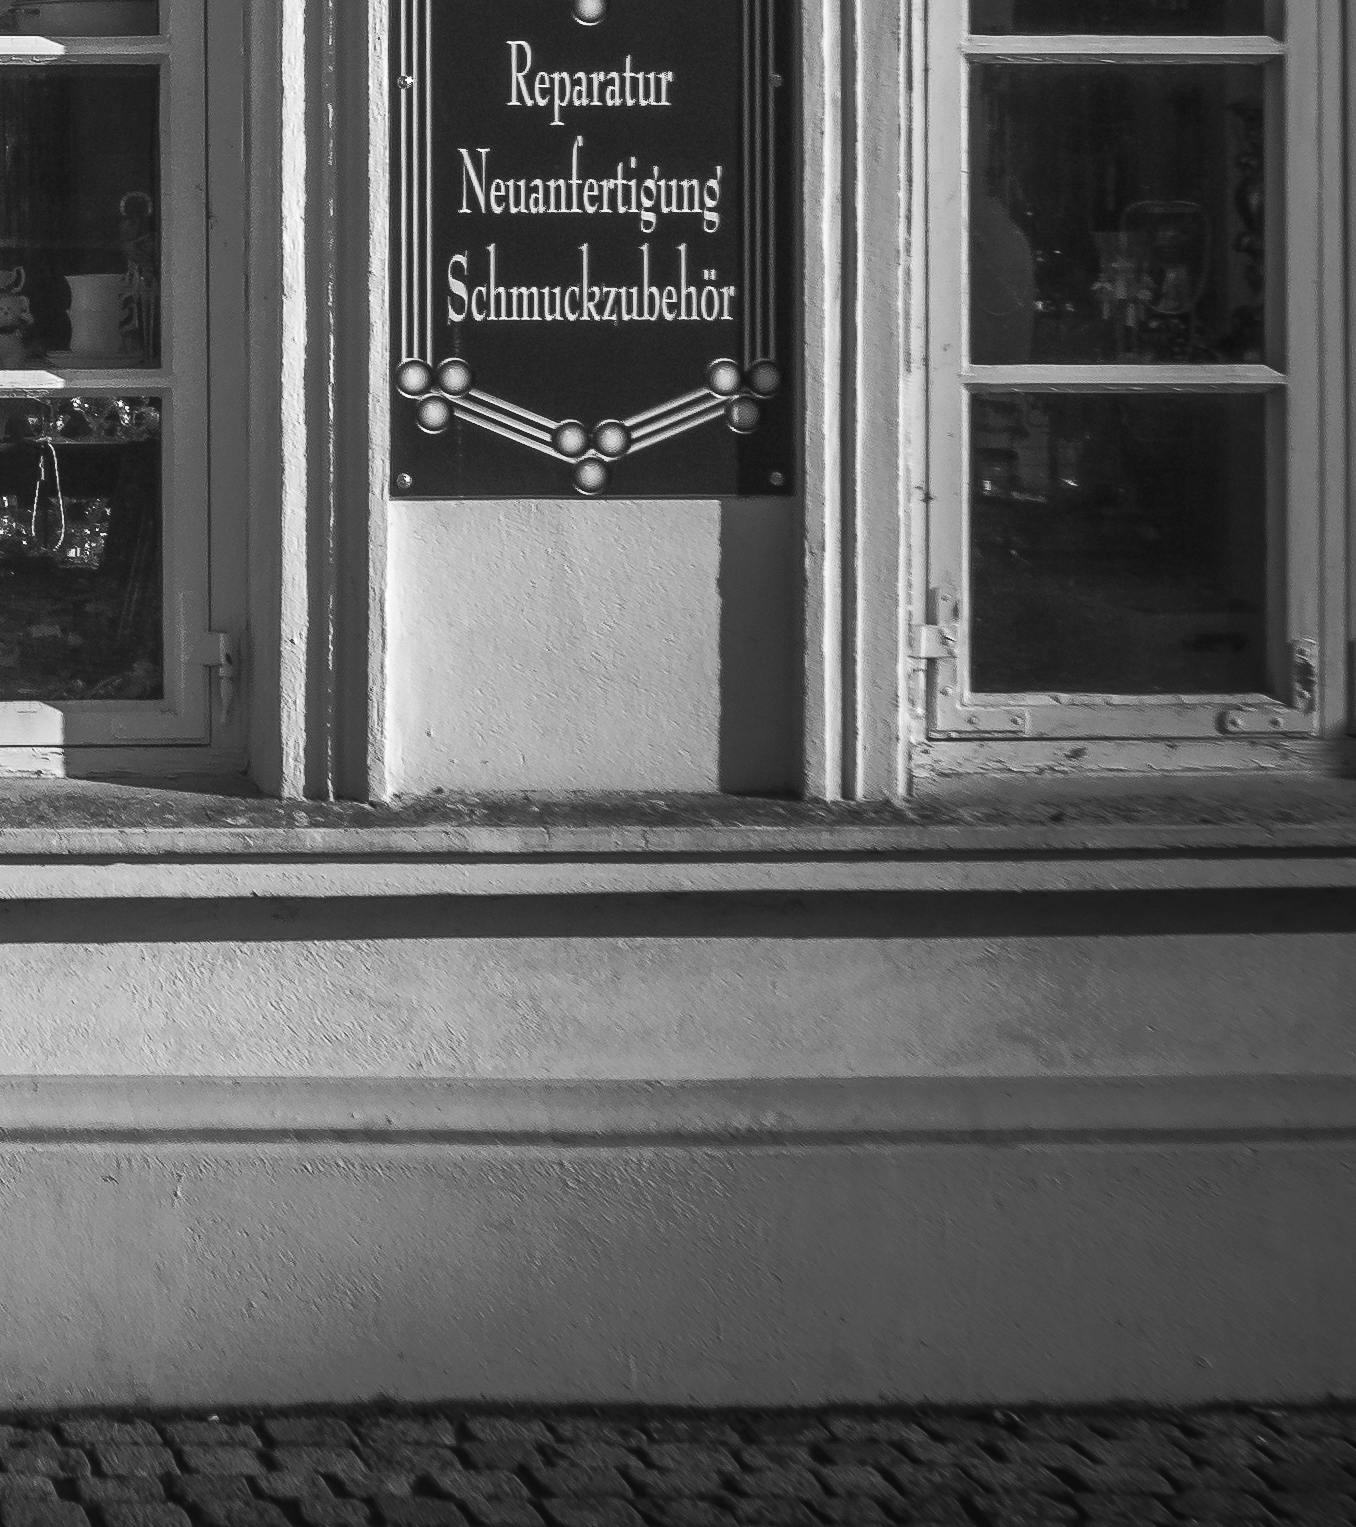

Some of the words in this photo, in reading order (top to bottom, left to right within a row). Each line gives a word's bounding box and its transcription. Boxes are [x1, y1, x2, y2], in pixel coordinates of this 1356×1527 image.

[506, 40, 674, 126] Reparatur
[457, 135, 723, 234] Neuanfertigung
[447, 242, 736, 326] Schmuckzubehör
